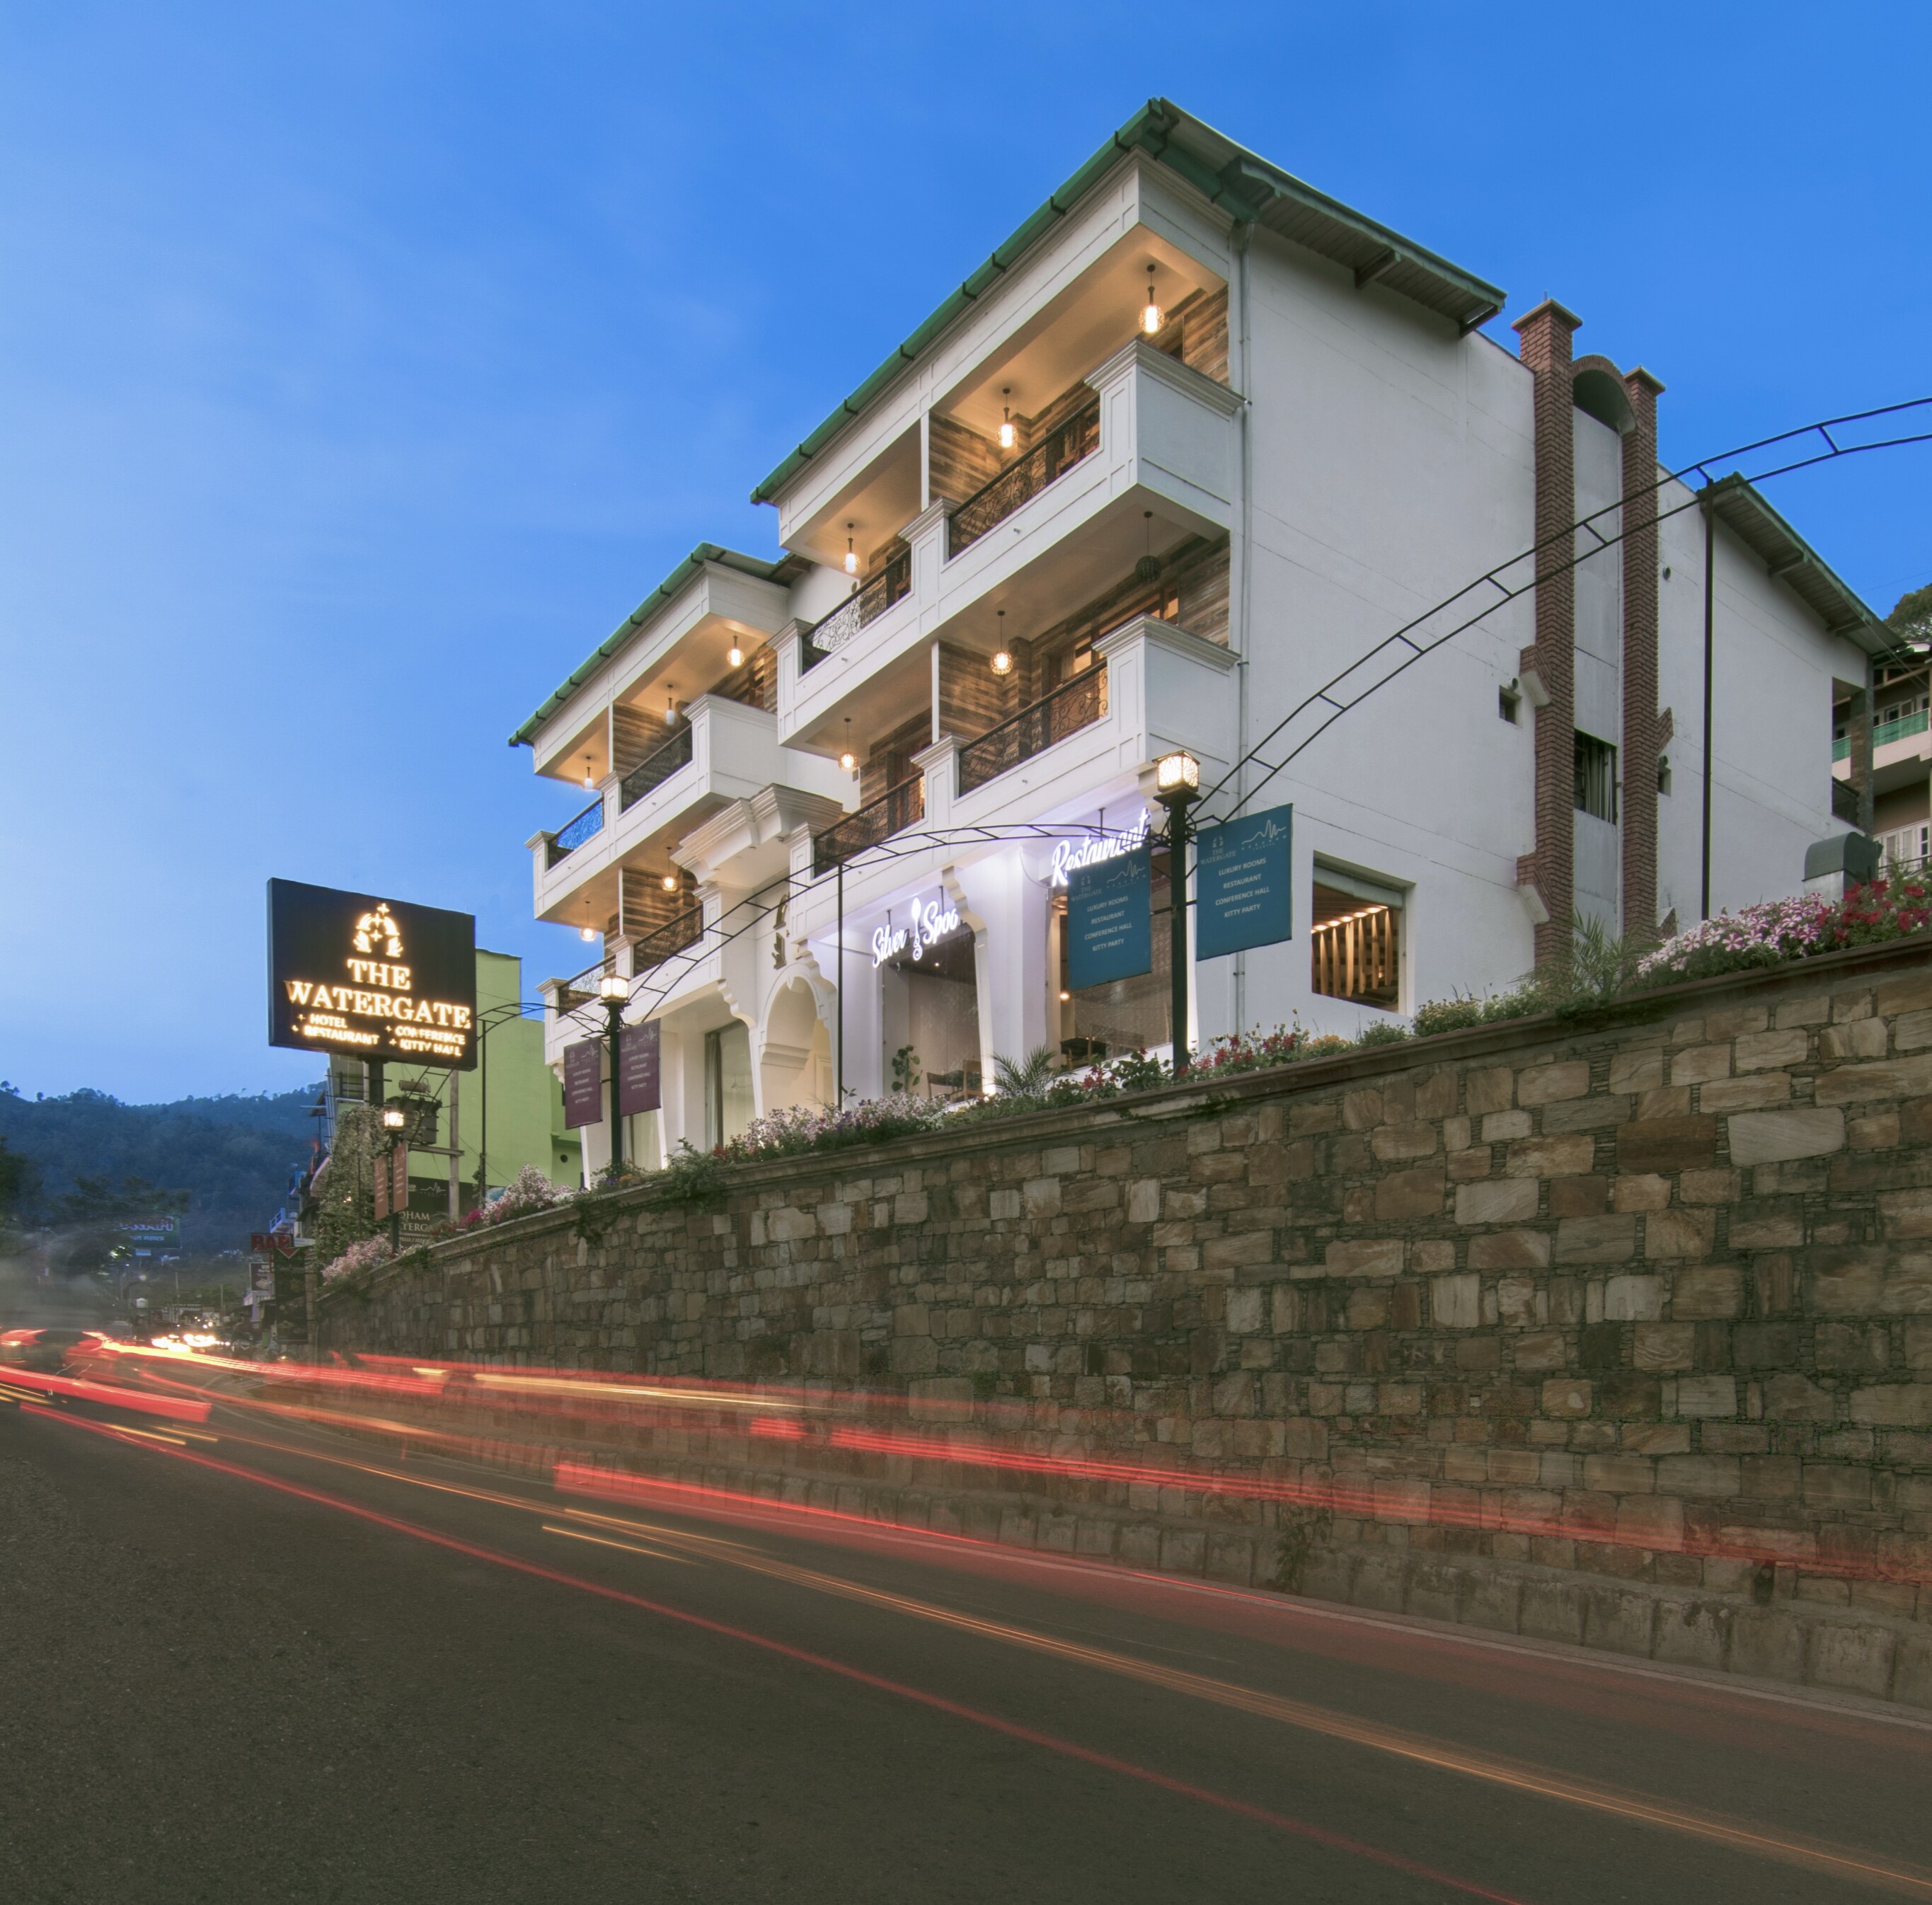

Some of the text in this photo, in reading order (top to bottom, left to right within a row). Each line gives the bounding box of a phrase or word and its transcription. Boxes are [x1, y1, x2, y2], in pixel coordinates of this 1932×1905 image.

[1052, 807, 1149, 887] Restaurant
[1200, 850, 1237, 865] WATERGATE
[1219, 858, 1267, 876] LUXURY ROOMS
[1223, 873, 1262, 889] RESTAURANT
[1087, 895, 1129, 912] LUXURY ROOMS
[1215, 886, 1270, 906] CONFERENCE HALL
[1091, 910, 1125, 924] RESTAURANT
[1224, 903, 1261, 918] KITTY PARTY
[873, 901, 959, 968] Silver Spoo
[1084, 922, 1132, 940] CONFERENCE HALL
[1092, 938, 1125, 952] KITTY PARTY
[347, 958, 411, 990] THE
[283, 979, 471, 1029] WATERGATE
[310, 1013, 347, 1029] HOTEL
[304, 1025, 380, 1045] RESTAURANT
[395, 1026, 466, 1045] CONFERENCE
[400, 1038, 462, 1057] KITTY HALL
